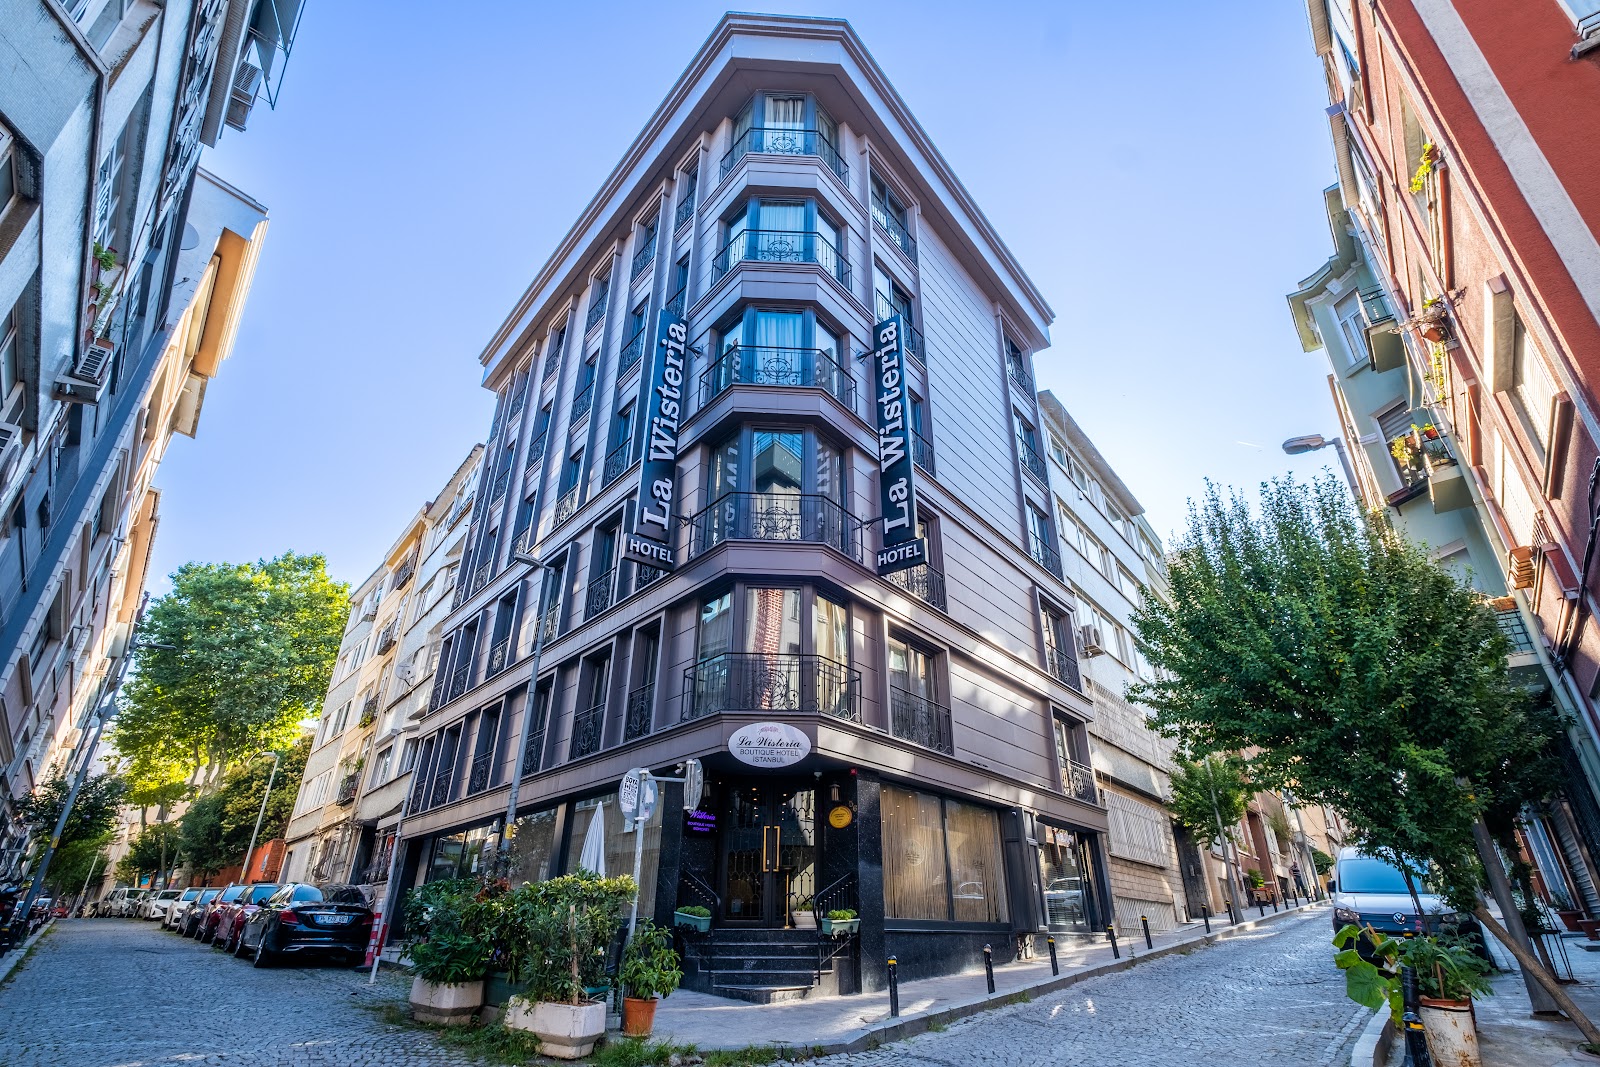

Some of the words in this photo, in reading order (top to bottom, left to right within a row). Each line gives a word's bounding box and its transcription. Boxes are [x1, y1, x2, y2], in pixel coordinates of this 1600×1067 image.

[649, 322, 687, 461] Wisteria
[875, 321, 905, 473] Wisteria
[643, 478, 673, 531] La
[883, 477, 910, 535] La
[629, 538, 674, 564] HOTEL
[877, 544, 921, 567] HOTEL
[736, 735, 754, 747] La
[756, 736, 802, 748] Wisteria
